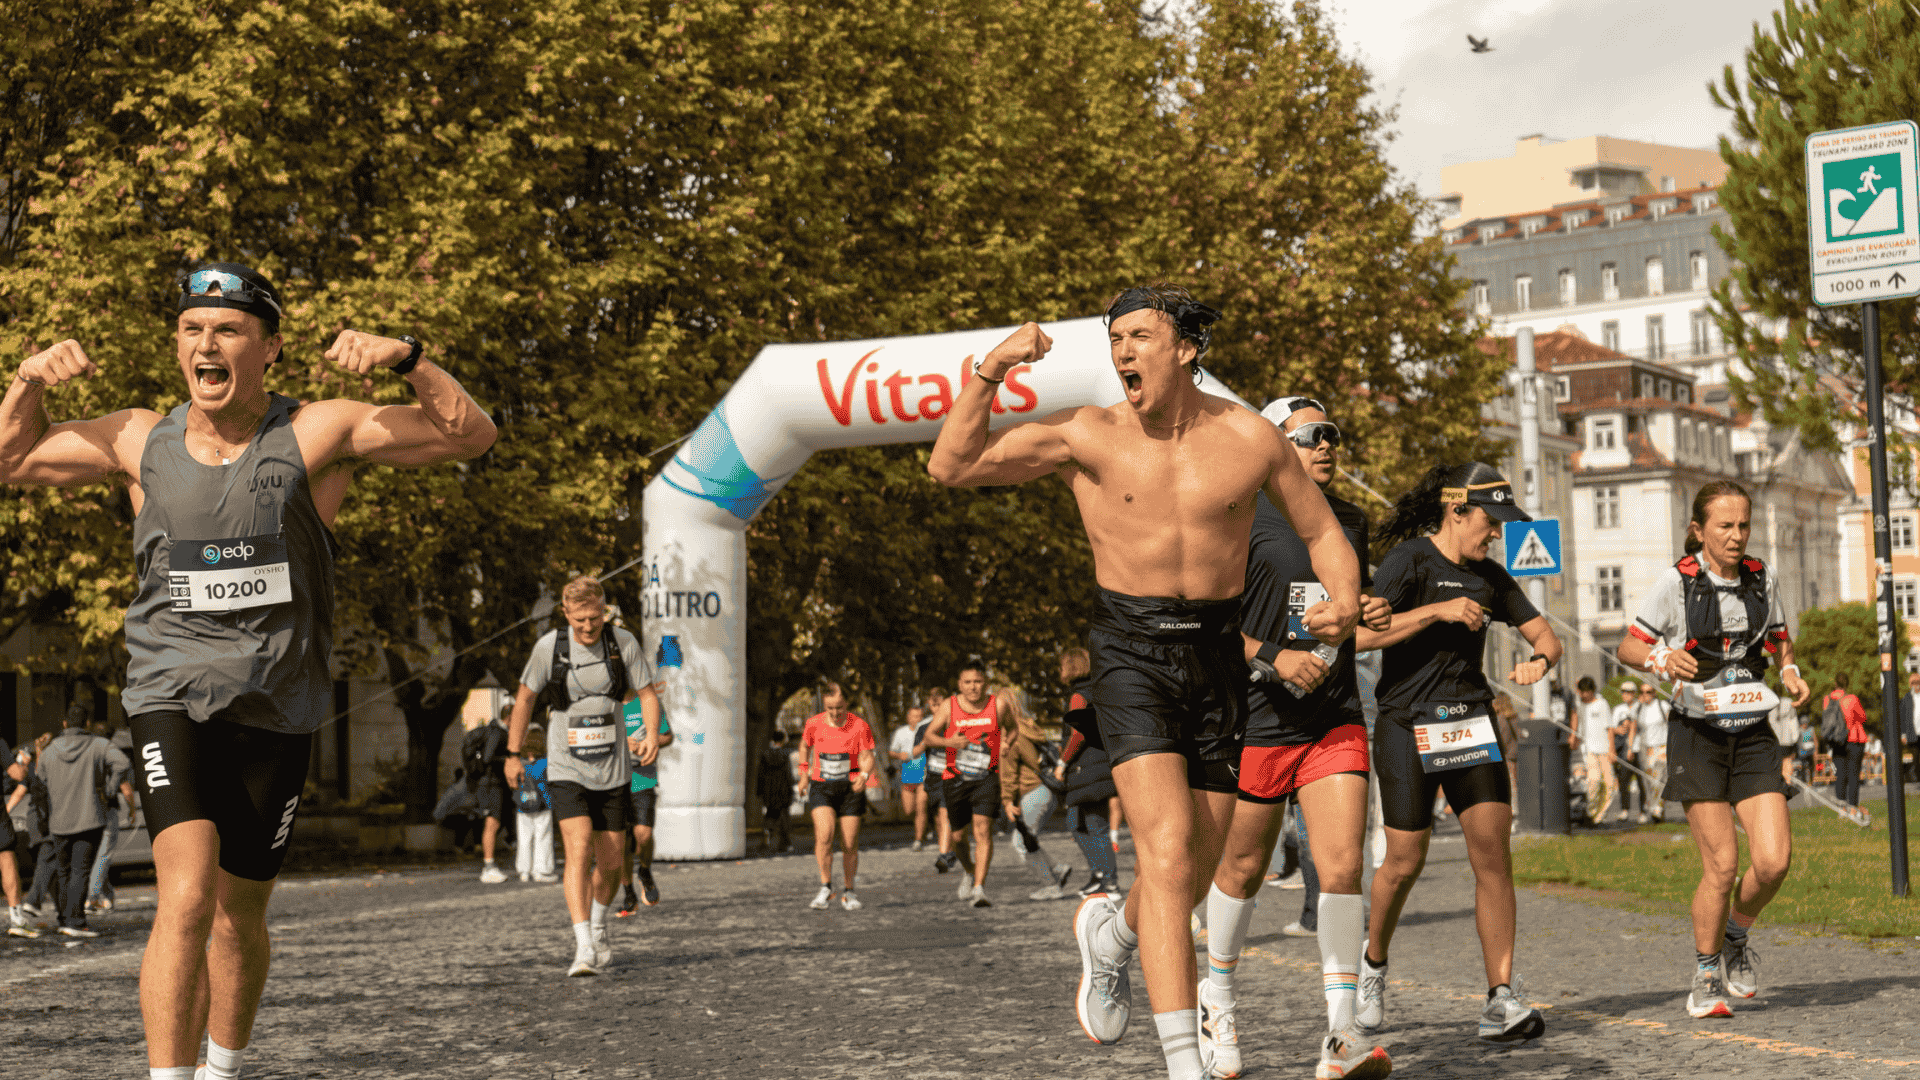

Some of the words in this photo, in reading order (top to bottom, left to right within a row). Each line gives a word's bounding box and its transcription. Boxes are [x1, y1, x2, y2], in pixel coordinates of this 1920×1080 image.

[1813, 146, 1849, 158] TSUNAMI
[1852, 141, 1884, 152] HAZARD
[1886, 138, 1908, 149] ZONE
[1832, 139, 1840, 147] DE
[1817, 247, 1854, 257] CAMINHO
[1868, 238, 1917, 250] EVACUAÇÃO
[1826, 253, 1878, 266] EVACUATION
[1880, 249, 1908, 259] ROUTE
[1830, 279, 1864, 293] 1000
[1870, 279, 1881, 288] m
[222, 541, 255, 561] edp
[254, 565, 284, 576] OYSHO
[205, 579, 267, 599] 10200
[1730, 691, 1763, 704] 2224
[1449, 702, 1468, 715] edp
[1442, 728, 1473, 743] 5374
[1449, 749, 1489, 764] HYUNDAI
